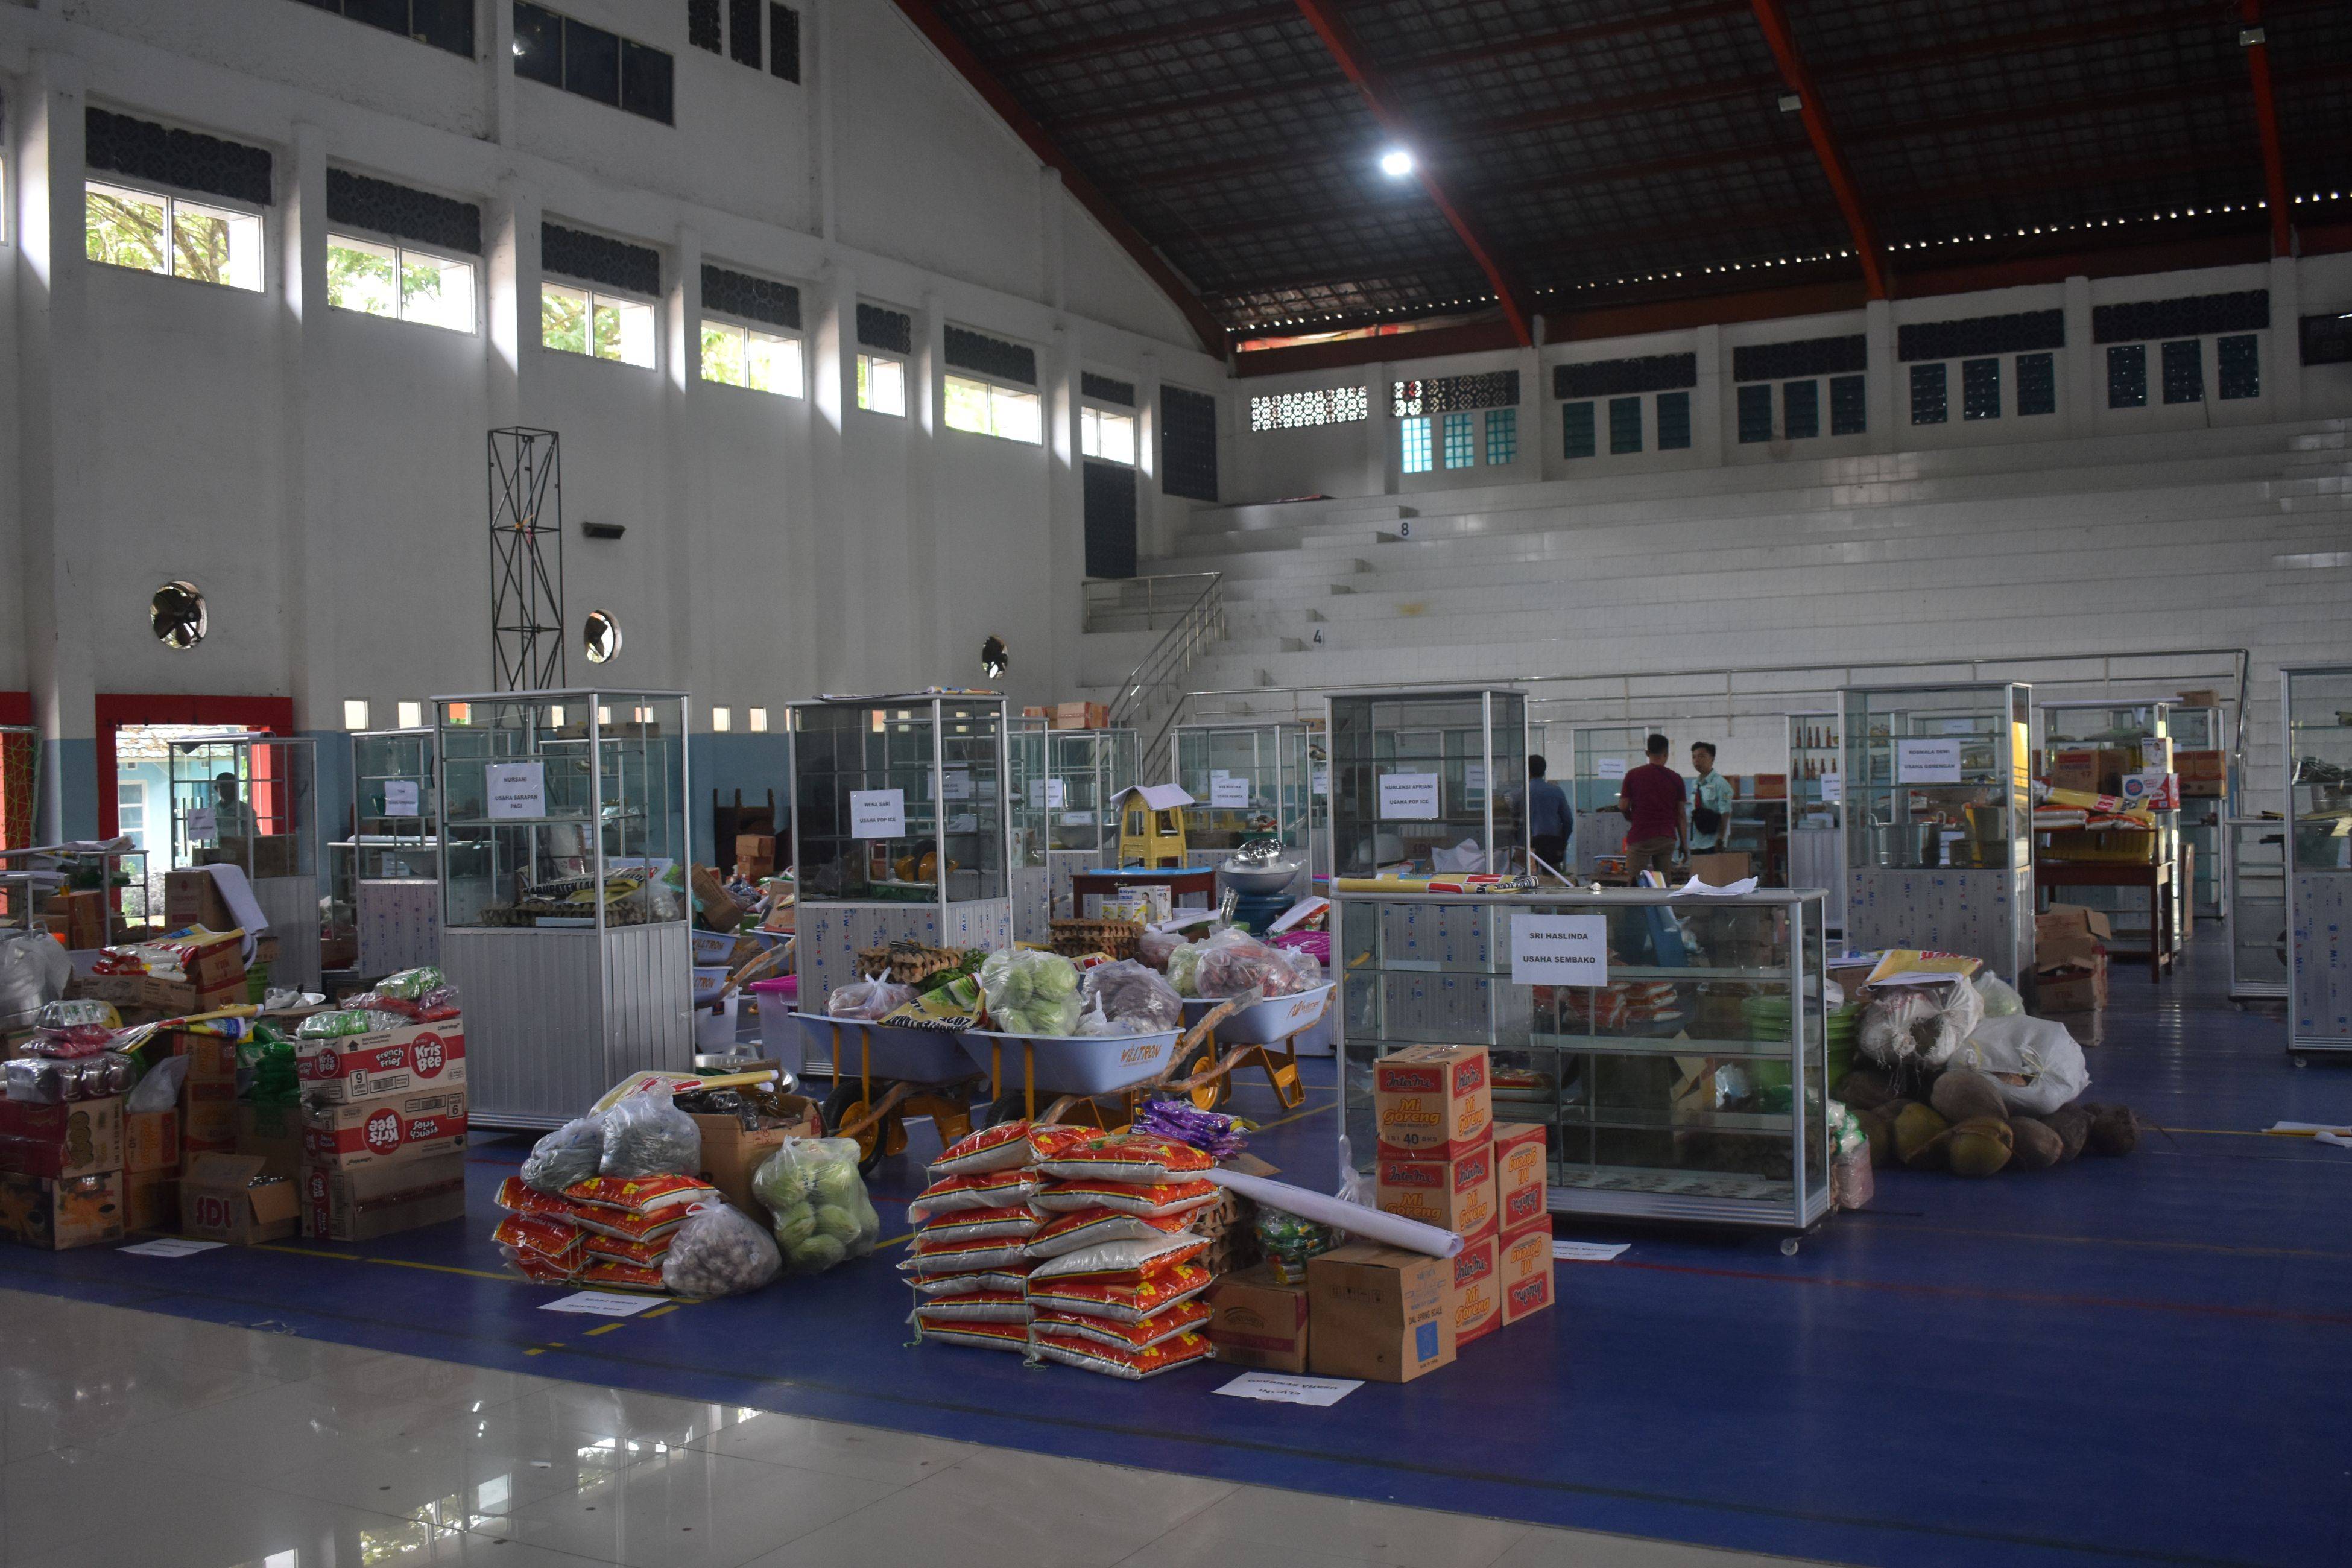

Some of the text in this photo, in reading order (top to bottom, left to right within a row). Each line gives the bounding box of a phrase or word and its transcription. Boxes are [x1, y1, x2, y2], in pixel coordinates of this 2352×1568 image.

[1401, 522, 1409, 536] 8
[1314, 630, 1321, 644] 4
[376, 1047, 404, 1061] French
[414, 1041, 441, 1060] Kris
[1121, 1043, 1162, 1062] WILLTRON
[380, 1055, 402, 1068] Fries
[416, 1056, 442, 1073] Bee
[356, 1072, 362, 1084] 9
[1399, 1098, 1421, 1113] Mi
[1465, 1095, 1475, 1114] Mi
[368, 1114, 398, 1133] Bee
[413, 1119, 435, 1130] Fries
[1383, 1108, 1441, 1126] Goreng
[1458, 1108, 1484, 1136] Goreng
[369, 1127, 399, 1146] Kris
[409, 1127, 438, 1140] French
[1403, 1133, 1419, 1145] 40
[1508, 1146, 1537, 1172] Goreng
[1518, 1167, 1529, 1186] Mi
[1400, 1192, 1424, 1207] Mi
[1467, 1189, 1478, 1207] Mi
[1385, 1202, 1442, 1221] Goreng
[1459, 1202, 1487, 1231] Goreng
[1510, 1236, 1542, 1264] Goreng
[1521, 1259, 1533, 1277] Mi
[1465, 1285, 1478, 1305] Mi
[1418, 1310, 1430, 1322] SPRING
[1431, 1306, 1443, 1317] SCALE
[1455, 1297, 1490, 1328] Goreng
